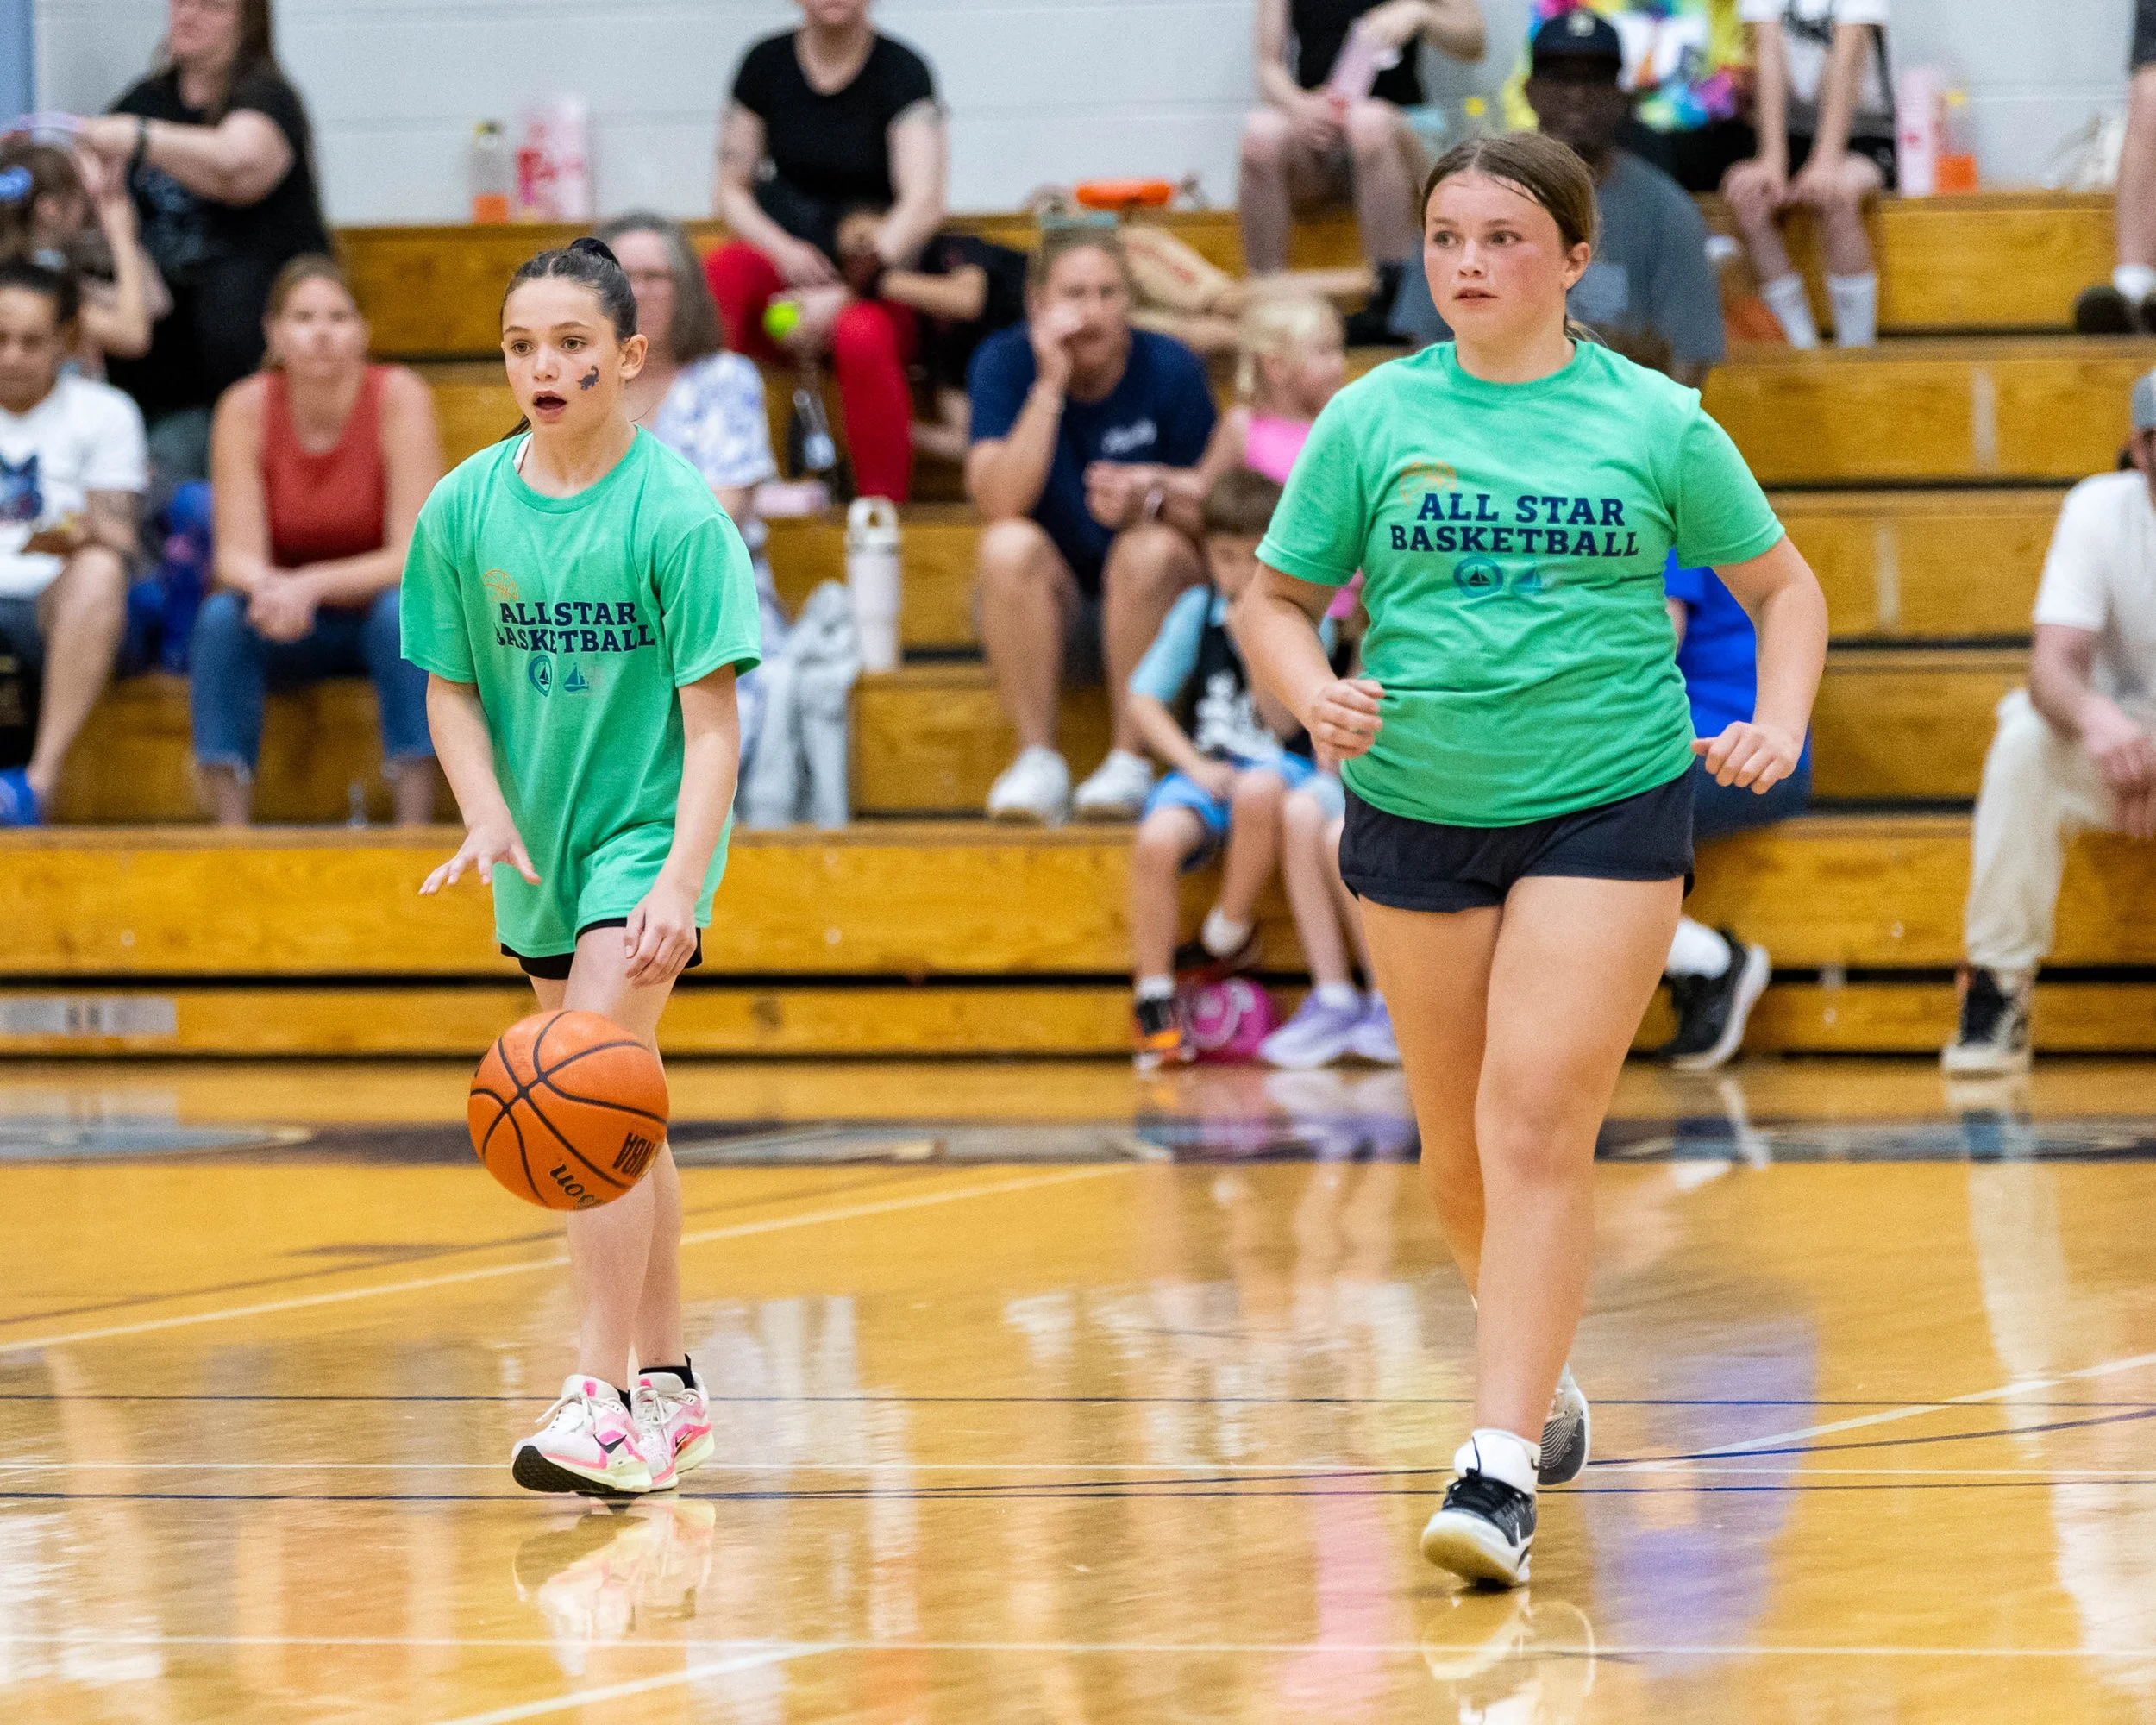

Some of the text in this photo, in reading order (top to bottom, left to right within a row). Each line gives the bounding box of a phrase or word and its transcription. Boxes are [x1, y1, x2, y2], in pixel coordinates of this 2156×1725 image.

[1417, 492, 1626, 526] ALL STAR
[1389, 524, 1639, 557] BASKETBALL
